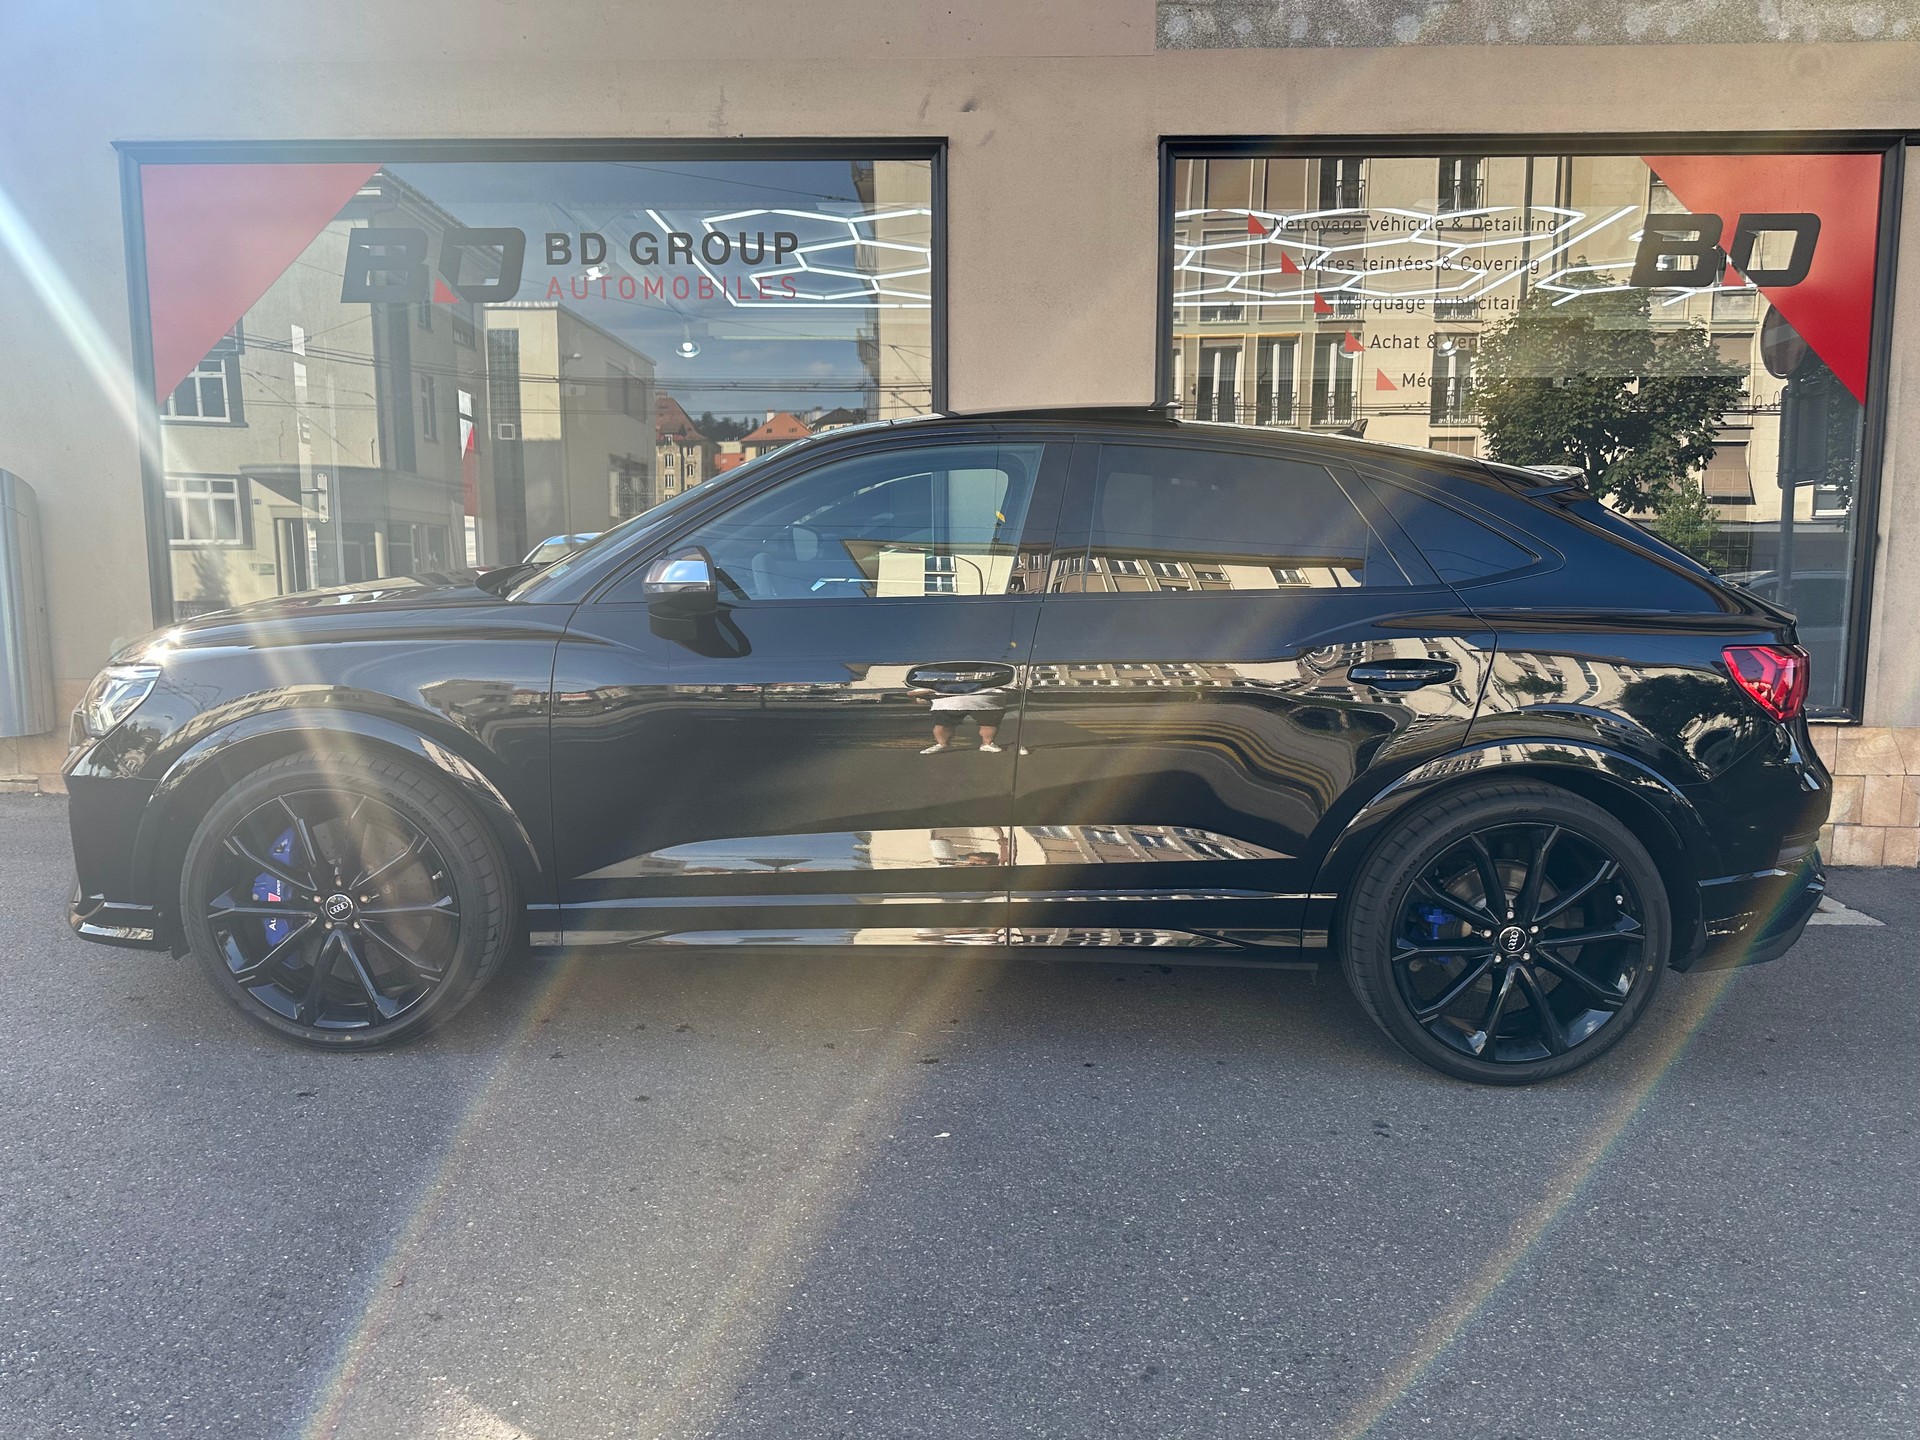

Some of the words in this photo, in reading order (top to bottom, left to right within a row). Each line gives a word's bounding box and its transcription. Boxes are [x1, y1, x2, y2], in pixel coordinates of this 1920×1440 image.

[1273, 217, 1362, 235] Nettoyage
[1369, 216, 1444, 231] véhicule
[1452, 217, 1463, 231] &
[545, 232, 607, 265] BD
[629, 231, 799, 266] GROUP
[1629, 213, 1821, 287] BD
[341, 227, 526, 303] BD
[1302, 256, 1355, 270] Vitres
[1363, 255, 1433, 270] teintées
[1441, 256, 1452, 270] &
[1460, 256, 1540, 274] Covering
[545, 275, 798, 300] AUTOMOBILES
[1340, 295, 1425, 313] Marquage
[1370, 334, 1420, 349] Achat
[1427, 334, 1438, 348] &
